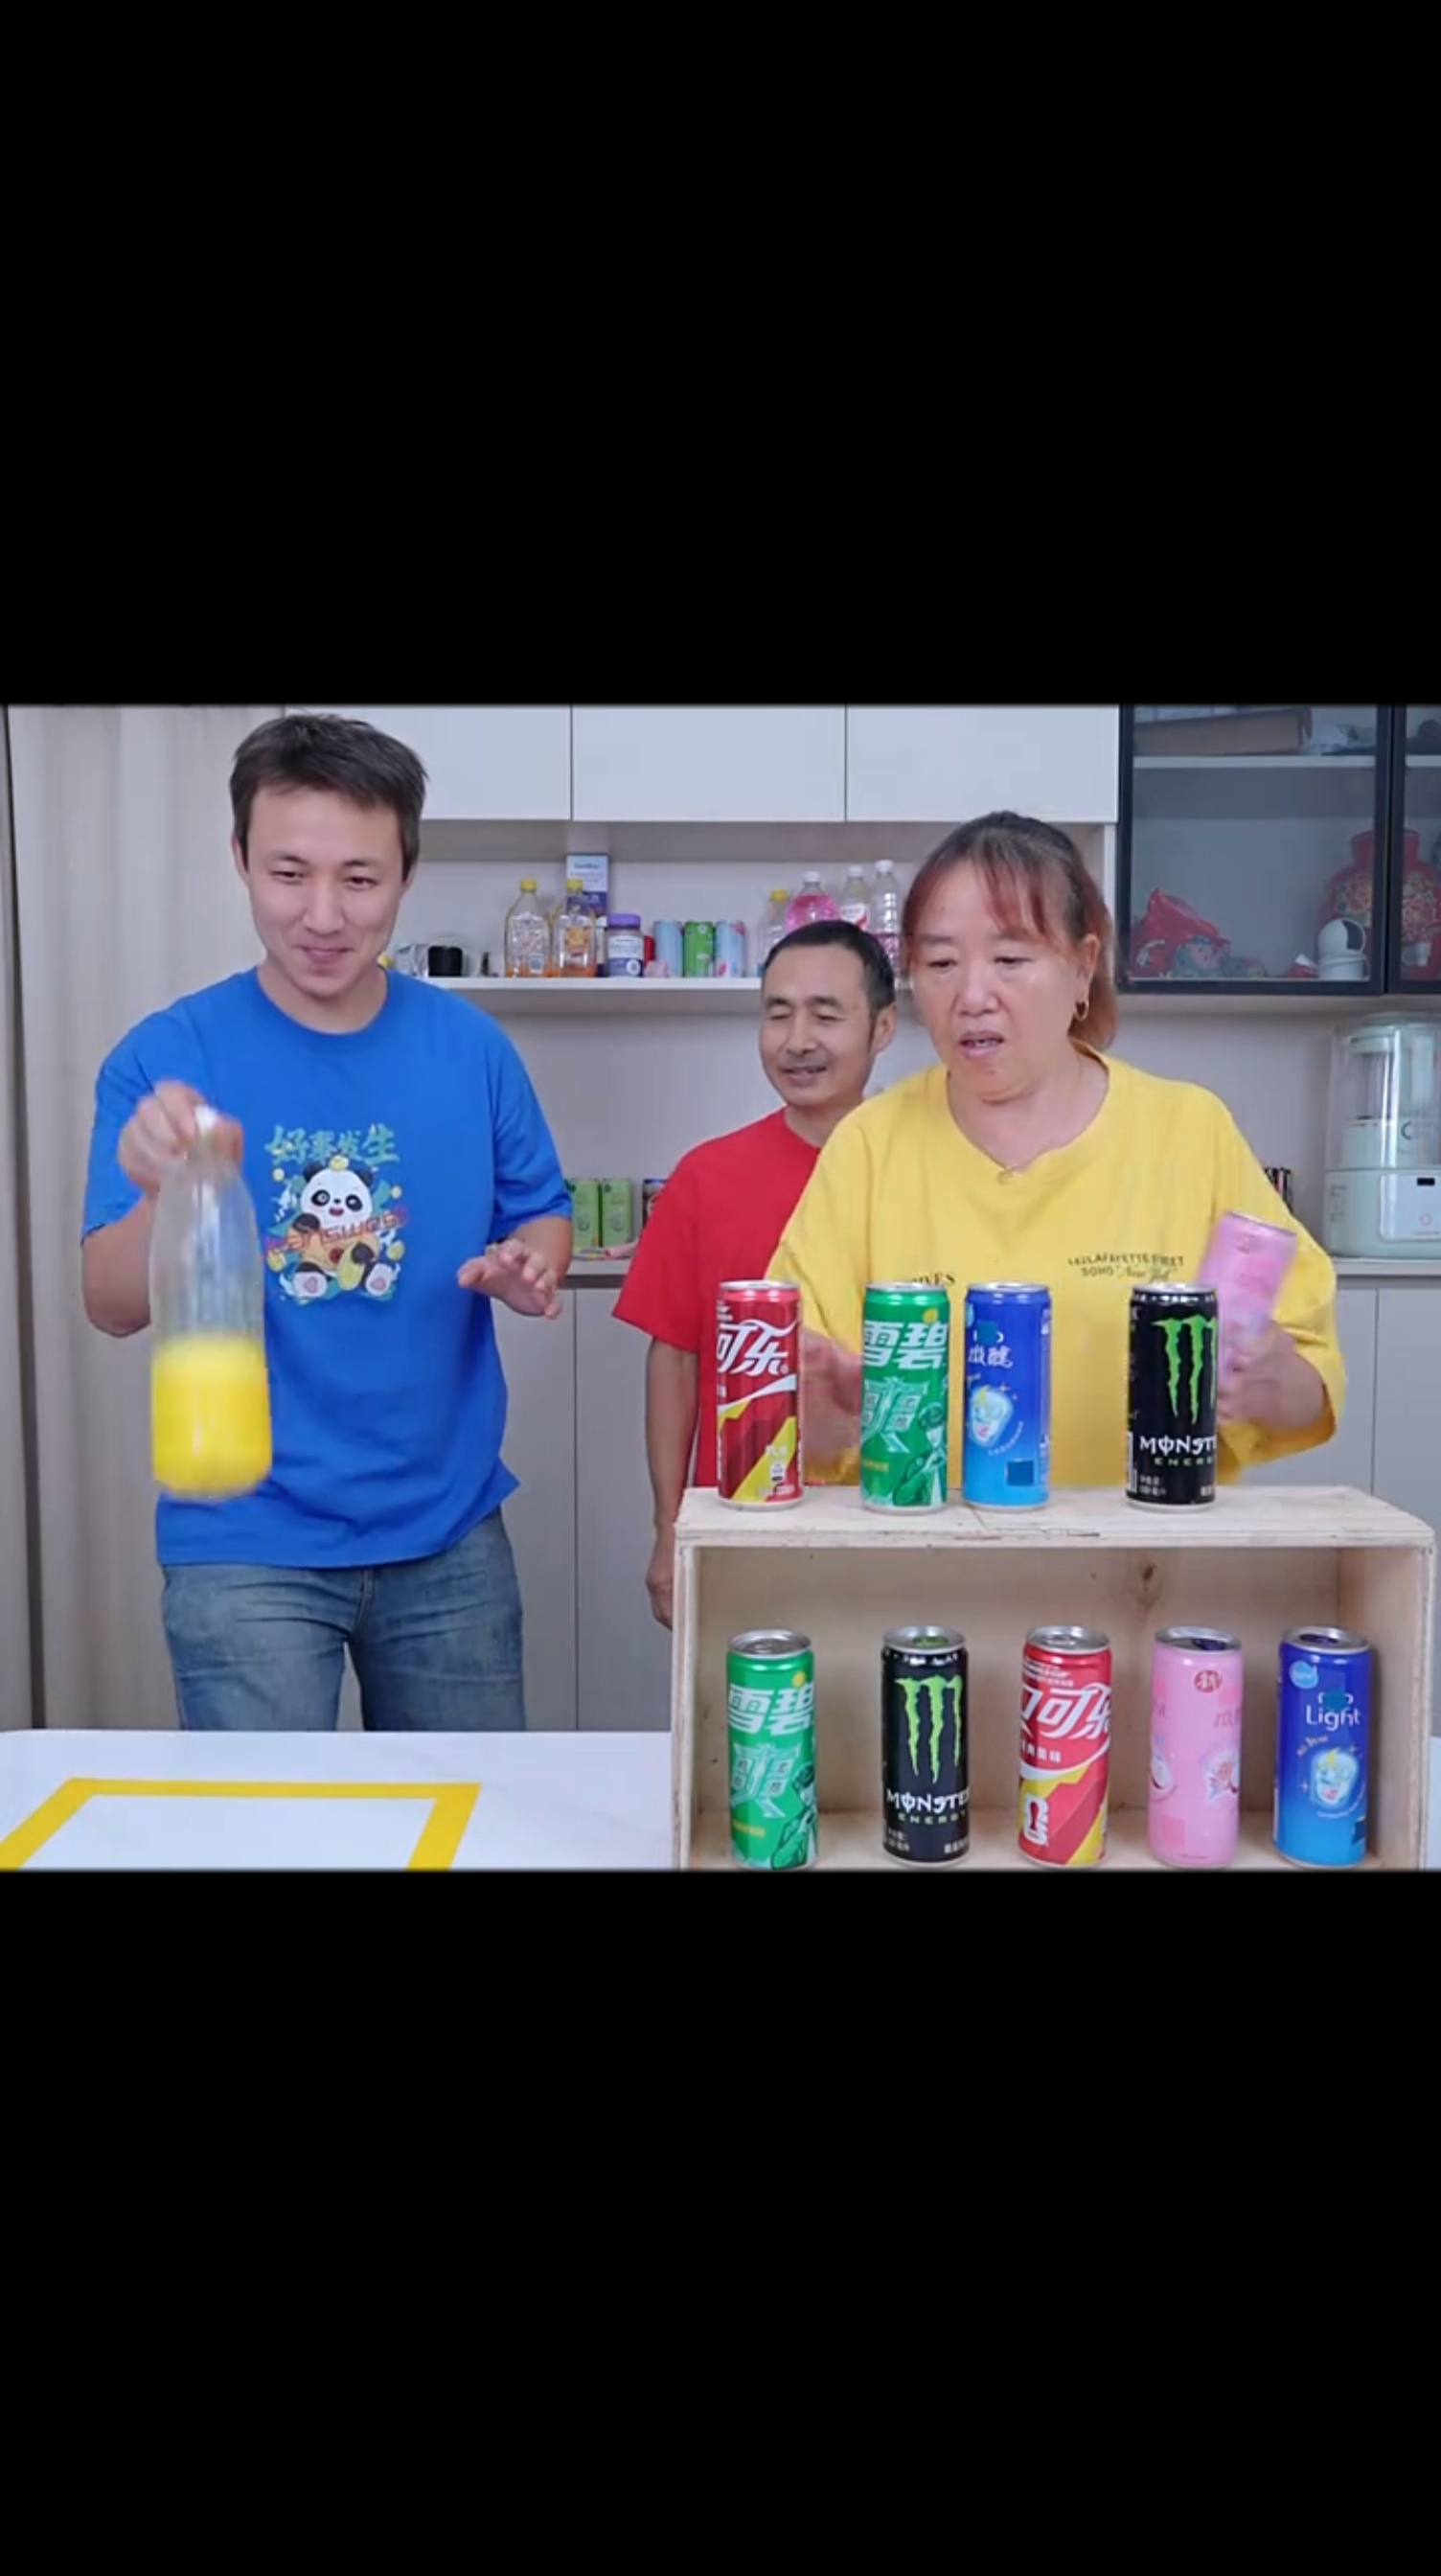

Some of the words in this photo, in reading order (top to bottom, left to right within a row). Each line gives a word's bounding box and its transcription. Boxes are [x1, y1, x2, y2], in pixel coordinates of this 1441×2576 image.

[864, 1319, 949, 1370] 雪碧
[728, 1681, 814, 1736] 雪碧
[1306, 1703, 1361, 1732] Light
